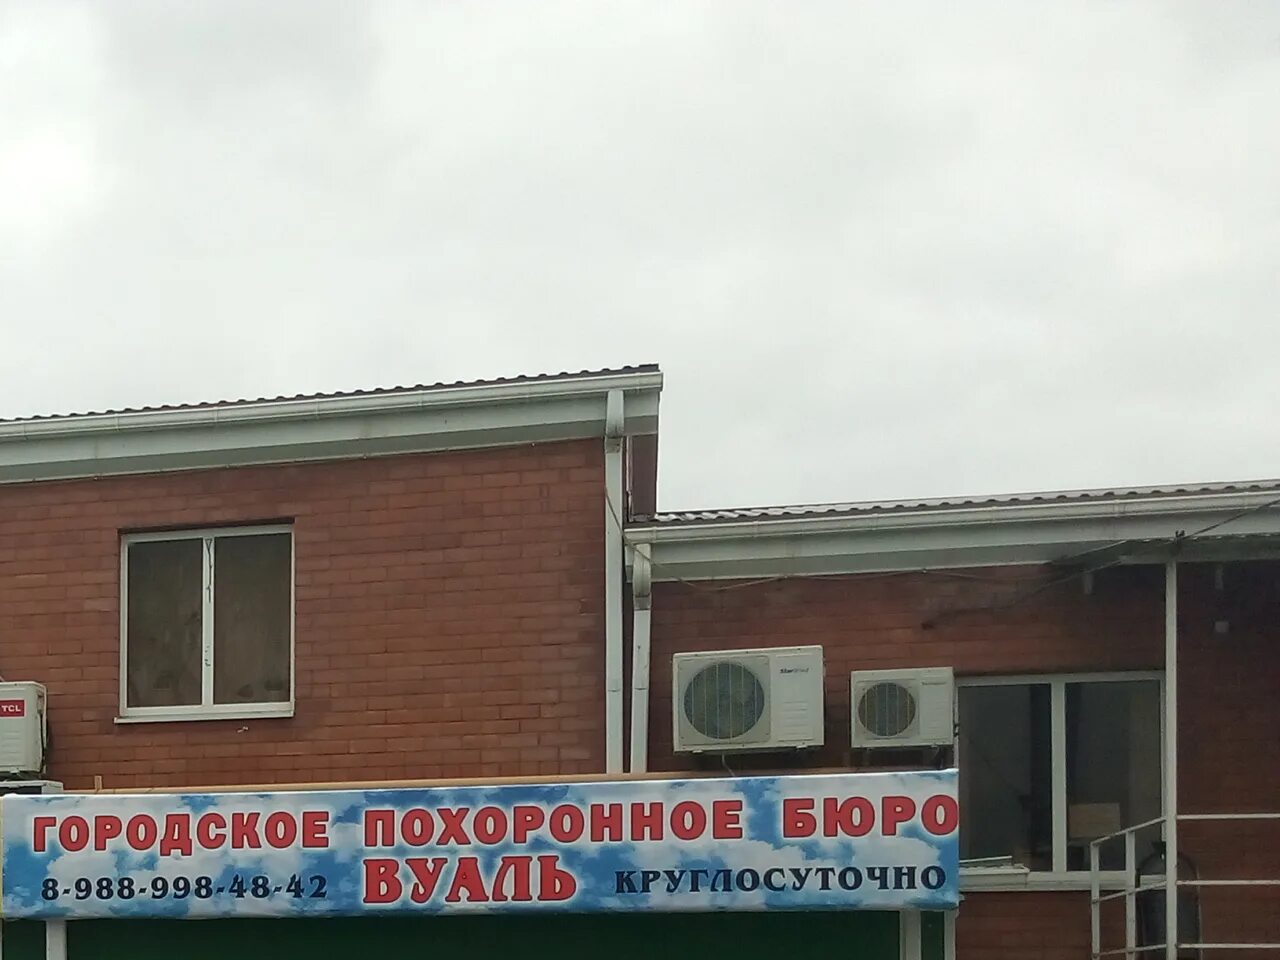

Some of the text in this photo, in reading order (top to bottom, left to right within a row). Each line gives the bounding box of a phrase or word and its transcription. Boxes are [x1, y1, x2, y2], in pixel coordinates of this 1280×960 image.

[1, 704, 22, 713] TCL
[32, 794, 959, 857] ГОРОДСКОЕ ПОХОРОННОЕ БЮРО
[40, 874, 329, 901] 8-988-998-48-42
[362, 855, 577, 904] ВУАЛЬ
[614, 865, 947, 894] КРУГЛОСУТОЧНО
